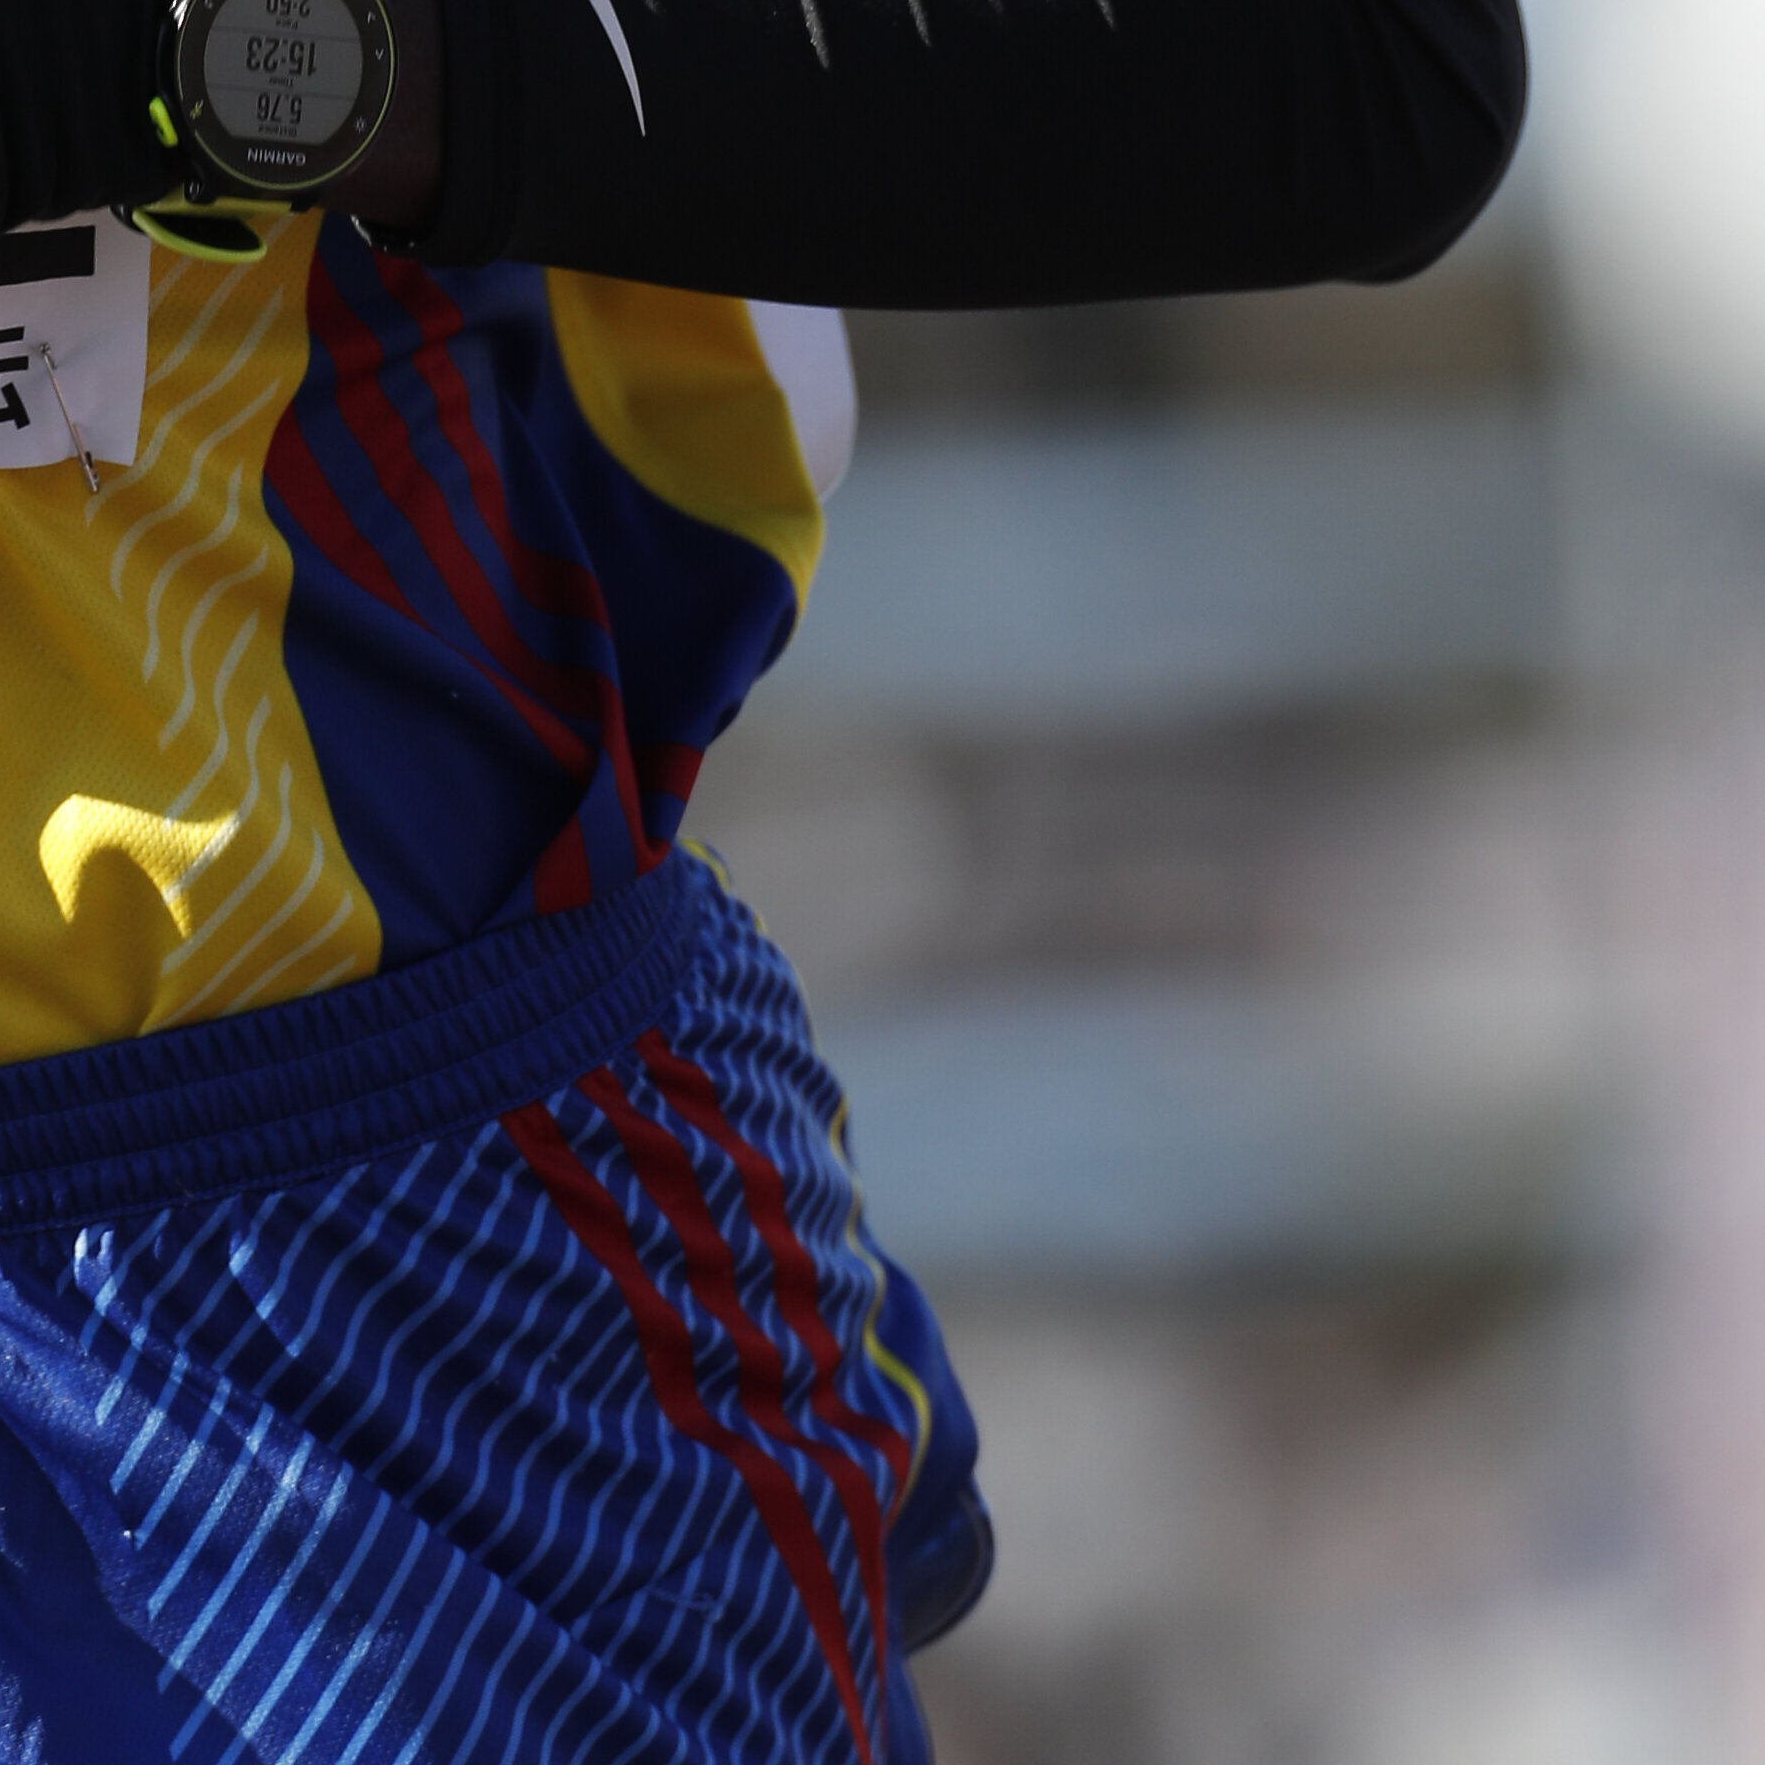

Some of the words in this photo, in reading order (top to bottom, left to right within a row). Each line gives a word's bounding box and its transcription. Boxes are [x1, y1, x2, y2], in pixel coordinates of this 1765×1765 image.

[246, 36, 316, 76] 15:23
[257, 93, 303, 124] 5.76
[246, 147, 307, 167] GARMIN
